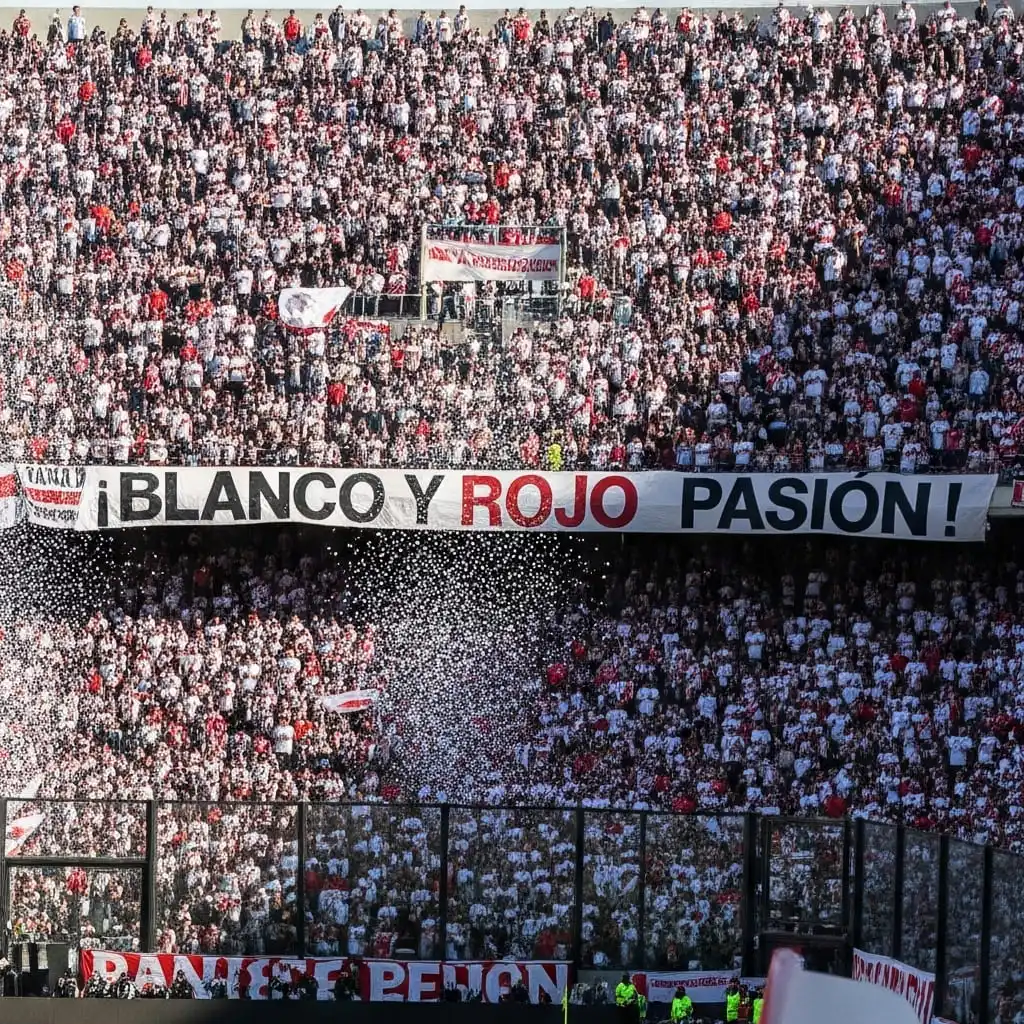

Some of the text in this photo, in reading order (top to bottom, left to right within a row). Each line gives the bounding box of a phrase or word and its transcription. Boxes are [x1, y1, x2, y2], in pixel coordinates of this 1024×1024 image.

[96, 471, 384, 527] ¡BLANCO
[405, 475, 445, 525] Y
[461, 475, 638, 529] ROJO
